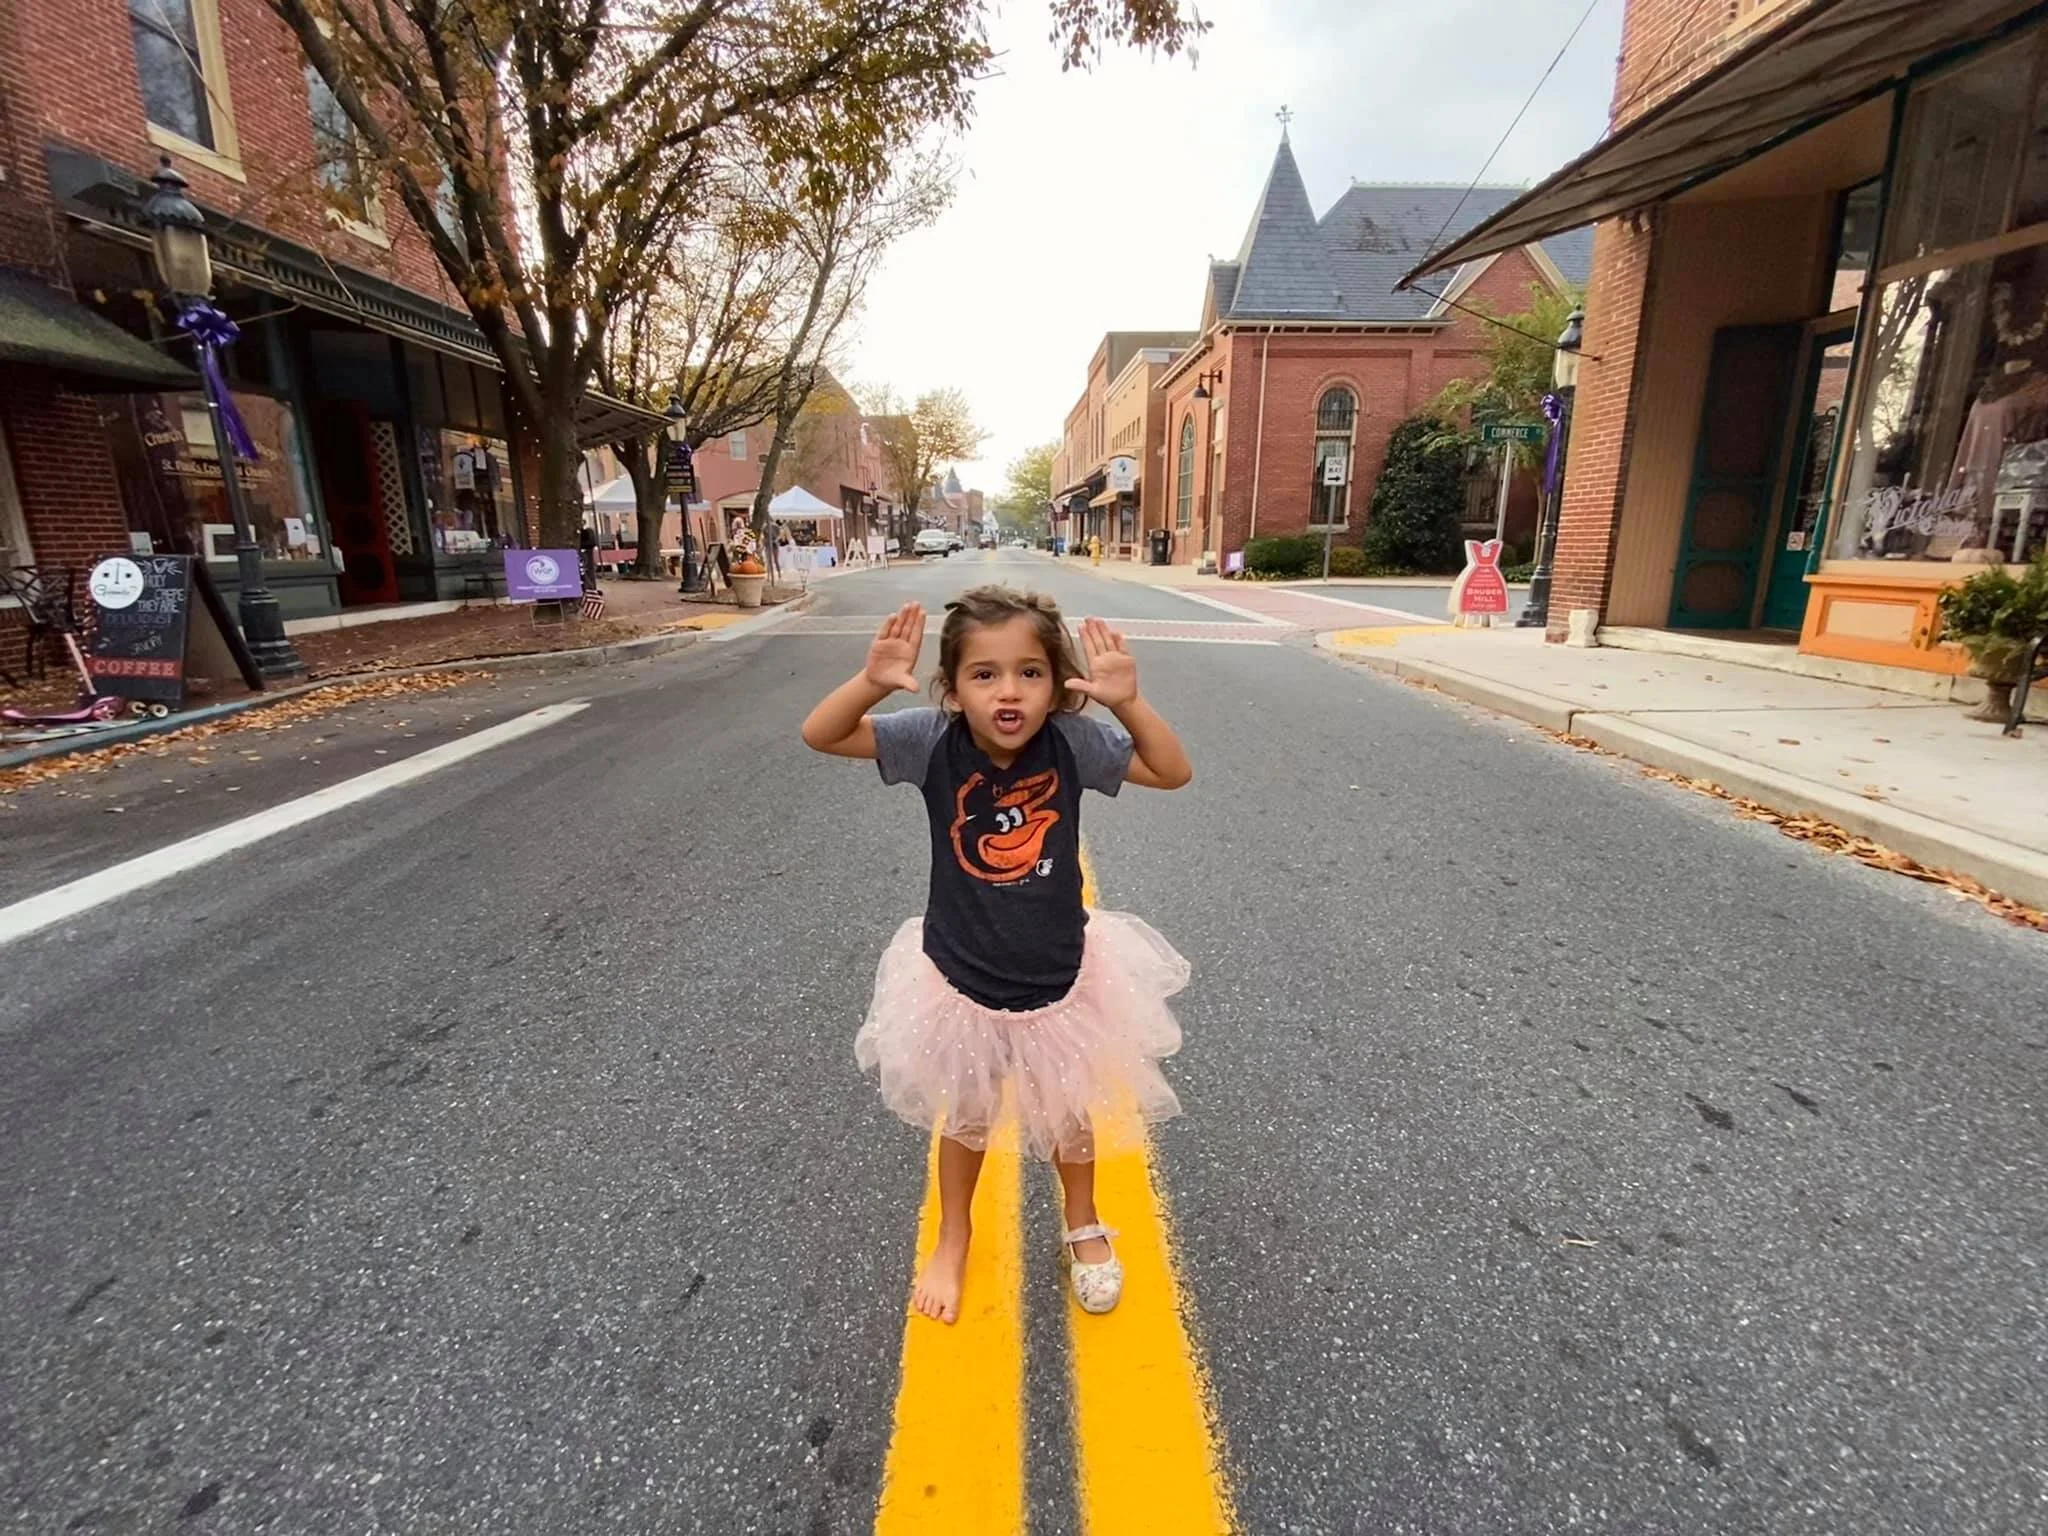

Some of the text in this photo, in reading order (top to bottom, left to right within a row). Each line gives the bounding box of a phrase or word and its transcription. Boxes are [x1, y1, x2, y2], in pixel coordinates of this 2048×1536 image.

[144, 430, 185, 447] Church
[1490, 427, 1529, 438] COMMERCE
[94, 659, 177, 676] COFFEE
